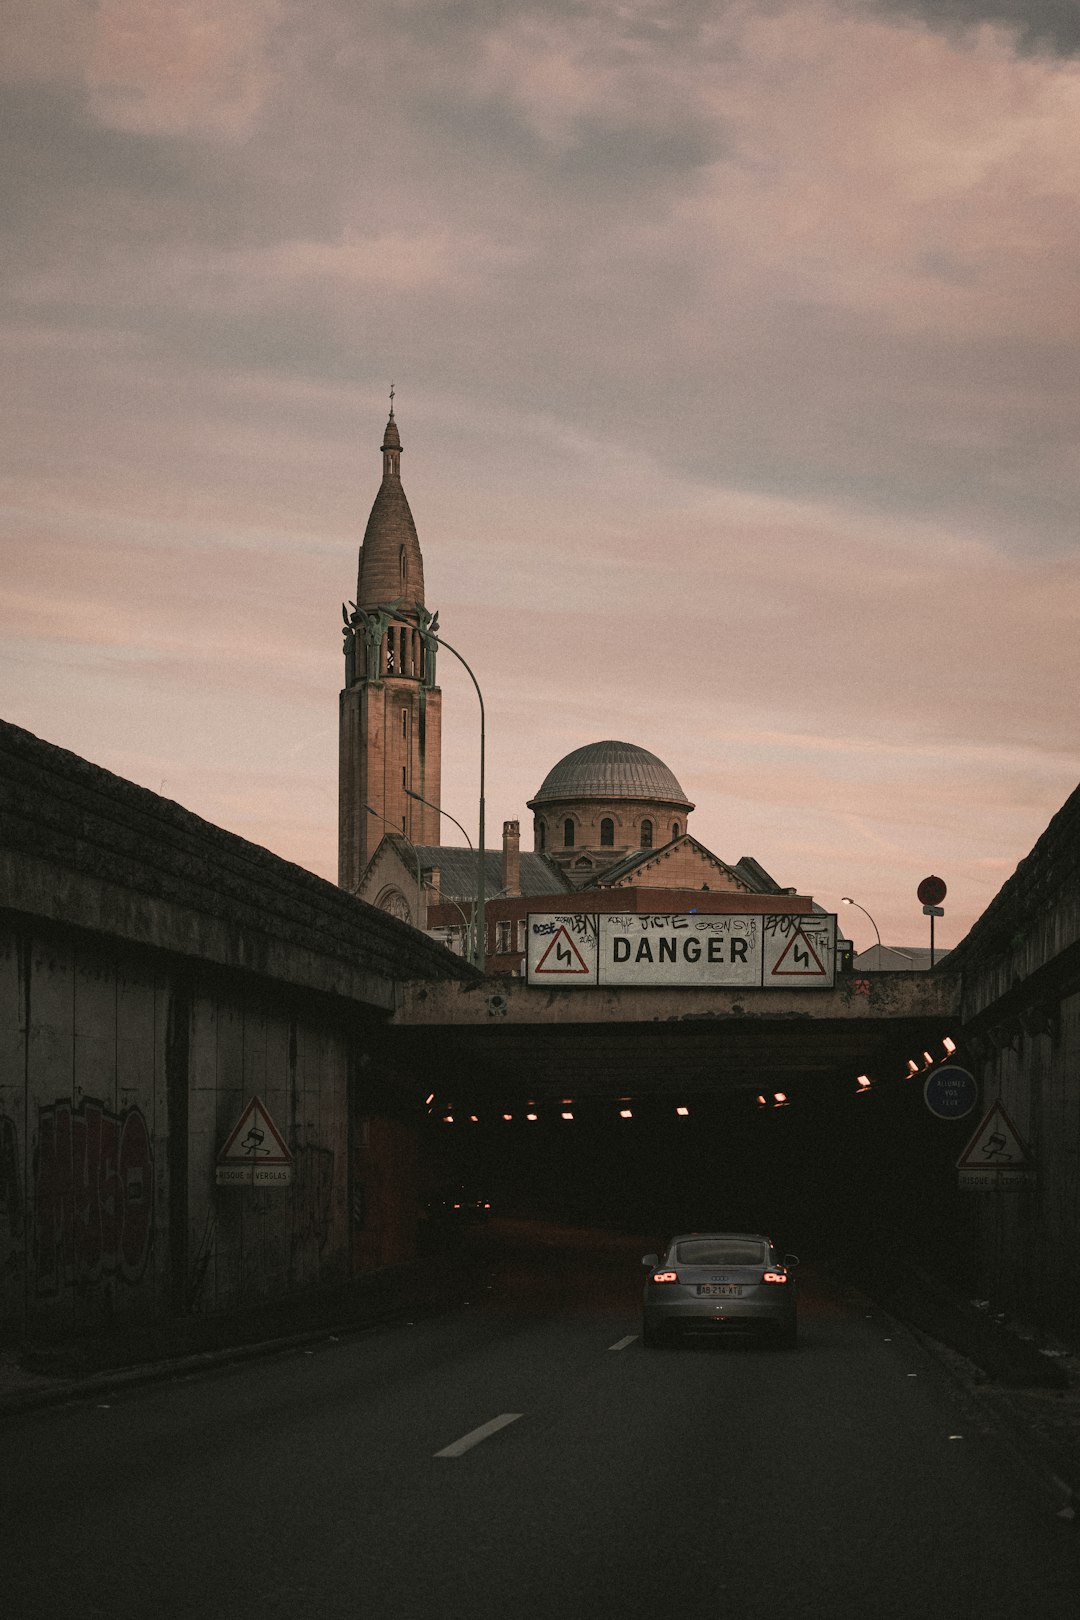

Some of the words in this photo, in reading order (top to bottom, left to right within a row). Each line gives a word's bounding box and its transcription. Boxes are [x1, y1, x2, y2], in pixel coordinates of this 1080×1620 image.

[613, 937, 748, 963] DANGER
[219, 1171, 244, 1179] RISQUE
[255, 1172, 287, 1180] VERGLAS
